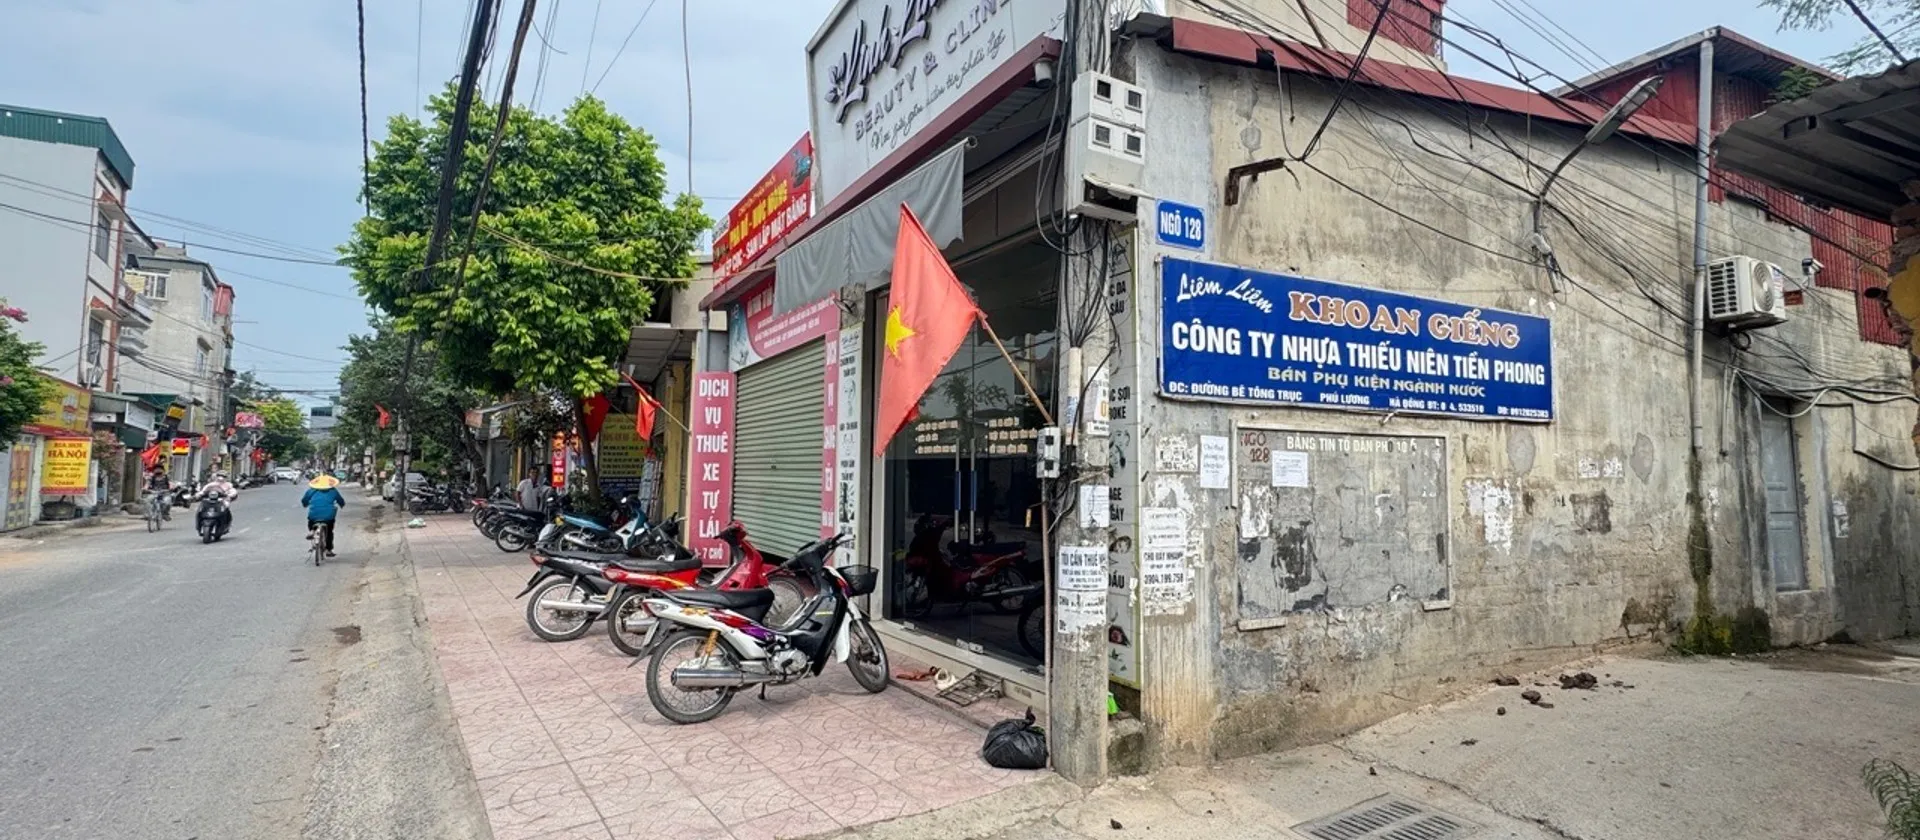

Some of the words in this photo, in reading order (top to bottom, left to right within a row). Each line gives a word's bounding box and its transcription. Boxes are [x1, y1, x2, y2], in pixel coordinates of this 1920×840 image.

[855, 66, 916, 141] BEAUTY
[923, 51, 938, 77] &
[1161, 210, 1182, 236] NGÕ
[1184, 217, 1201, 241] 128
[1177, 273, 1223, 303] Liêm
[1225, 278, 1273, 314] Liêm
[1288, 291, 1421, 337] KHOAN
[1428, 309, 1521, 349] GIẾNG
[1171, 318, 1241, 355] CÔNG
[1248, 330, 1275, 359] TY
[1282, 334, 1341, 369] NHỰA
[1346, 340, 1401, 371] THIẾU
[1406, 348, 1449, 377] NIÊN
[1494, 360, 1545, 385] PHONG
[699, 379, 729, 401] DỊCH
[1268, 366, 1307, 383] BÁN
[1313, 371, 1348, 389] PHỤ
[1354, 374, 1390, 391] KIỆN
[1393, 379, 1445, 395] NGÀNH
[1449, 381, 1486, 397] NƯỚC
[1169, 381, 1189, 393] ĐC:
[1191, 380, 1229, 397] ĐƯỜNG
[1277, 390, 1303, 402] TRỤC
[1320, 390, 1338, 403] PHÚ
[1341, 394, 1370, 406] LƯƠNG
[1389, 396, 1401, 407] HÀ
[1402, 397, 1425, 409] ĐÔNG
[704, 406, 721, 429] VỤ
[48, 449, 64, 458] HÀ
[66, 449, 87, 459] NỘI
[696, 431, 728, 453] THUÊ
[1287, 433, 1316, 450] BẢNG
[1319, 438, 1335, 451] TIN
[1353, 437, 1373, 452] DÂN
[1250, 447, 1270, 463] 128
[703, 463, 720, 482] XE
[702, 489, 720, 514] TỰ
[699, 516, 720, 538] LÁI
